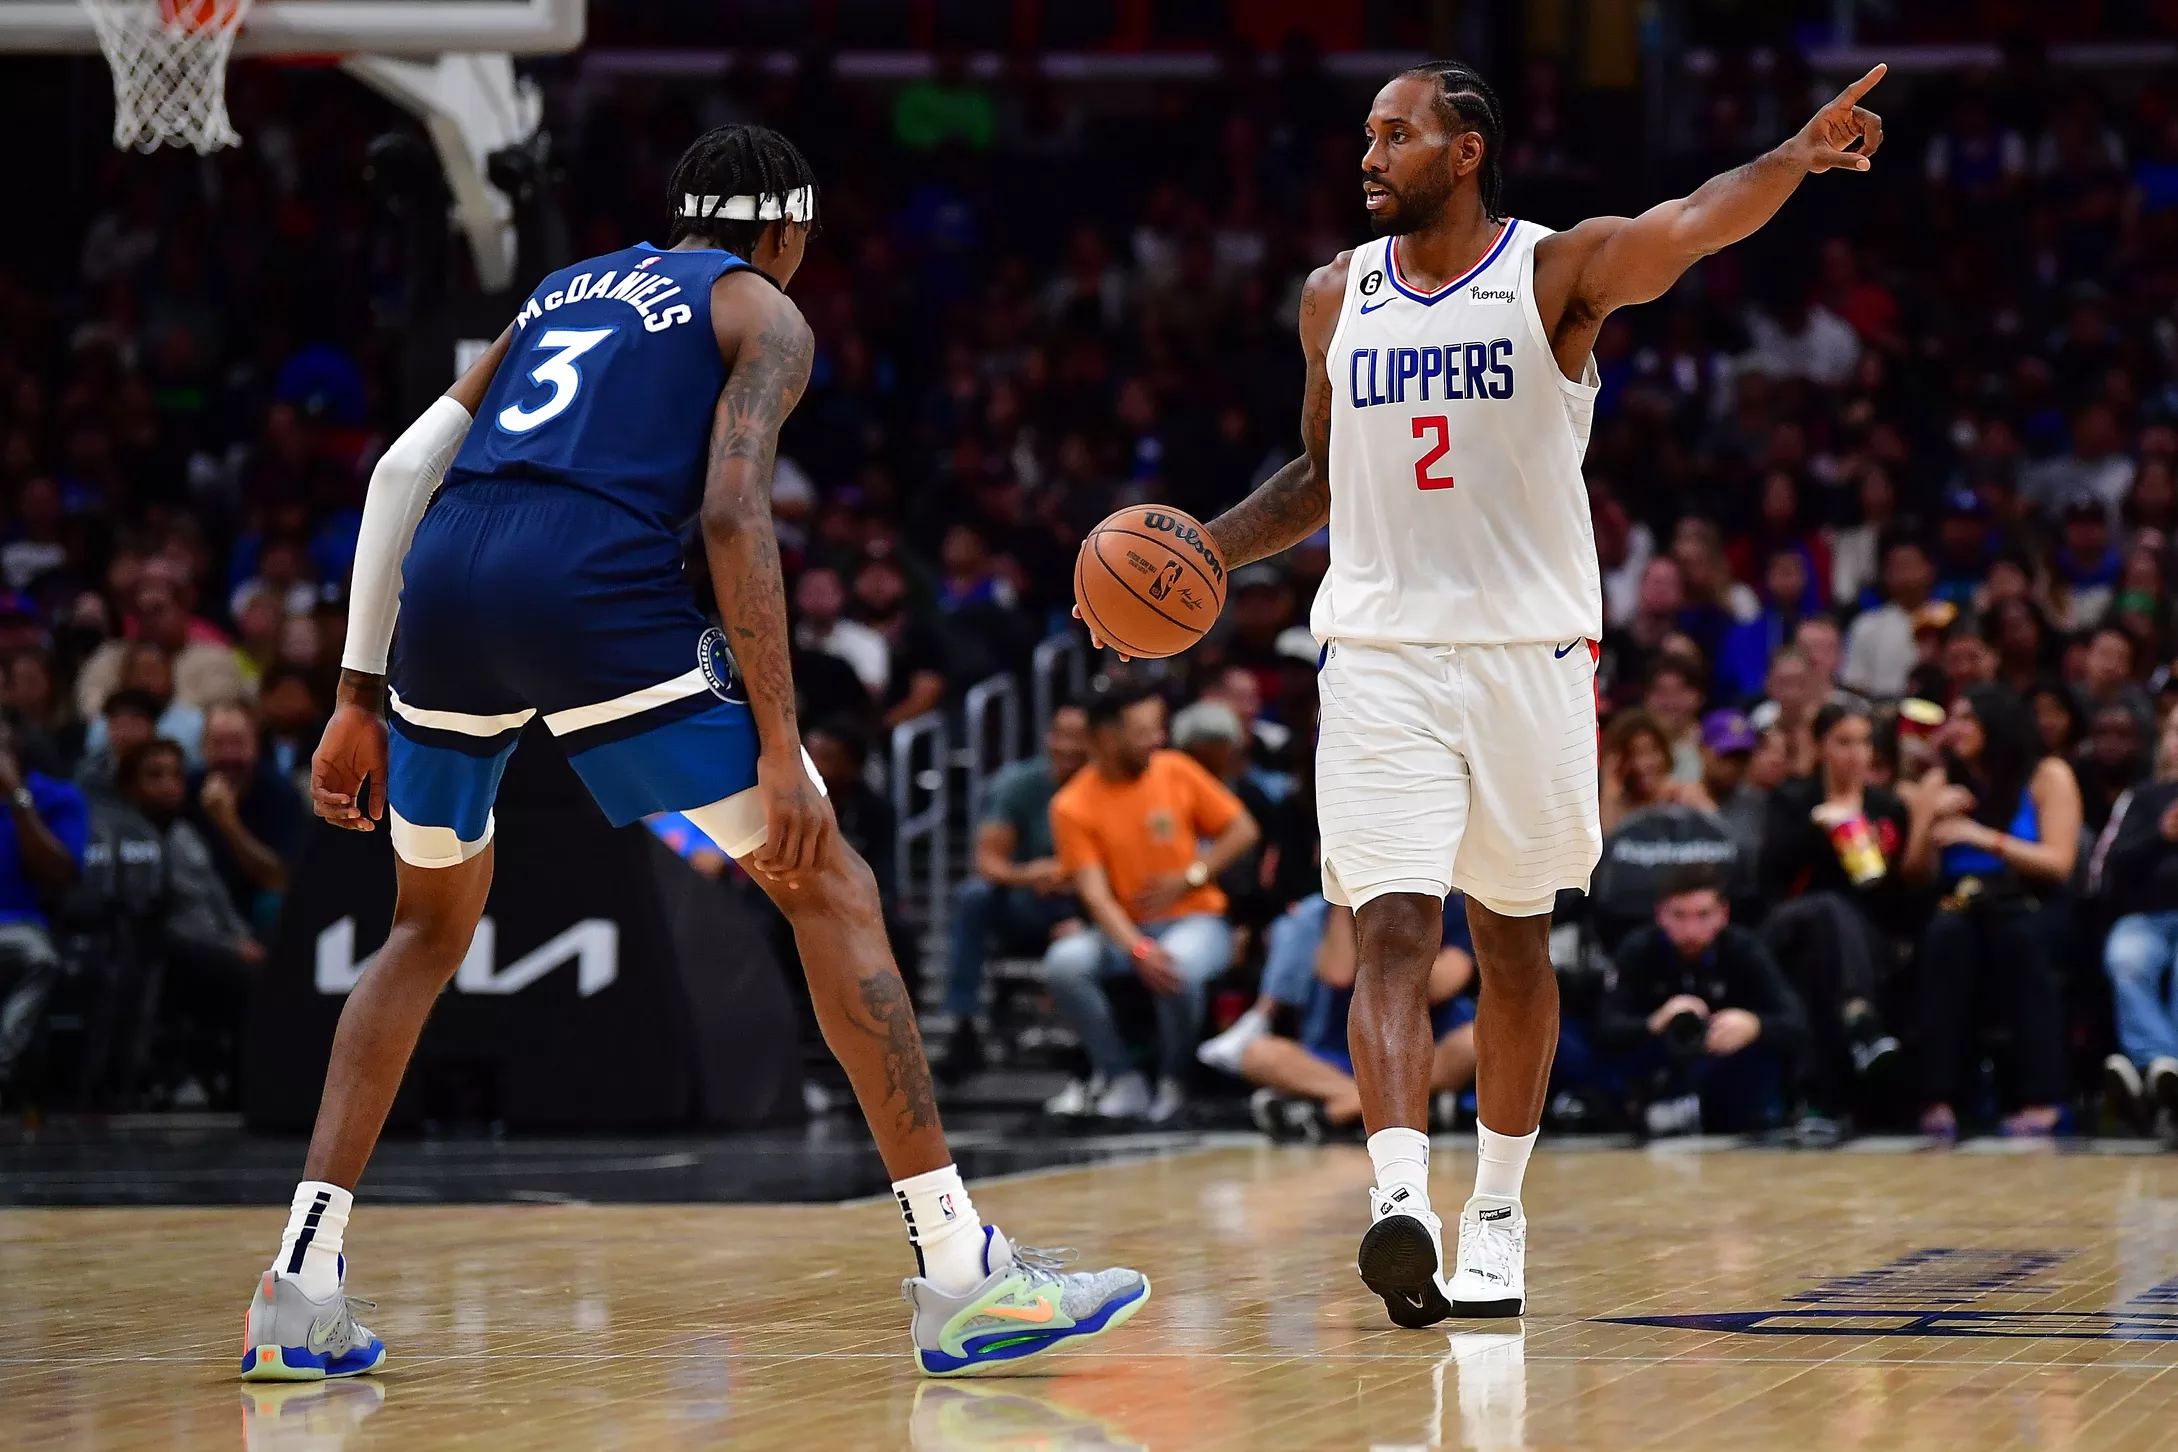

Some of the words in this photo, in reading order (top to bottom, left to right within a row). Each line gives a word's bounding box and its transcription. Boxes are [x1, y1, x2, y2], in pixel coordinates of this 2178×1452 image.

[1364, 273, 1379, 293] 6
[1469, 285, 1516, 304] honey
[496, 327, 619, 434] 3
[1350, 337, 1515, 409] CLIPPERS
[1411, 414, 1455, 491] 2
[1143, 511, 1224, 586] Wilson
[700, 636, 720, 690] MINNESOTA
